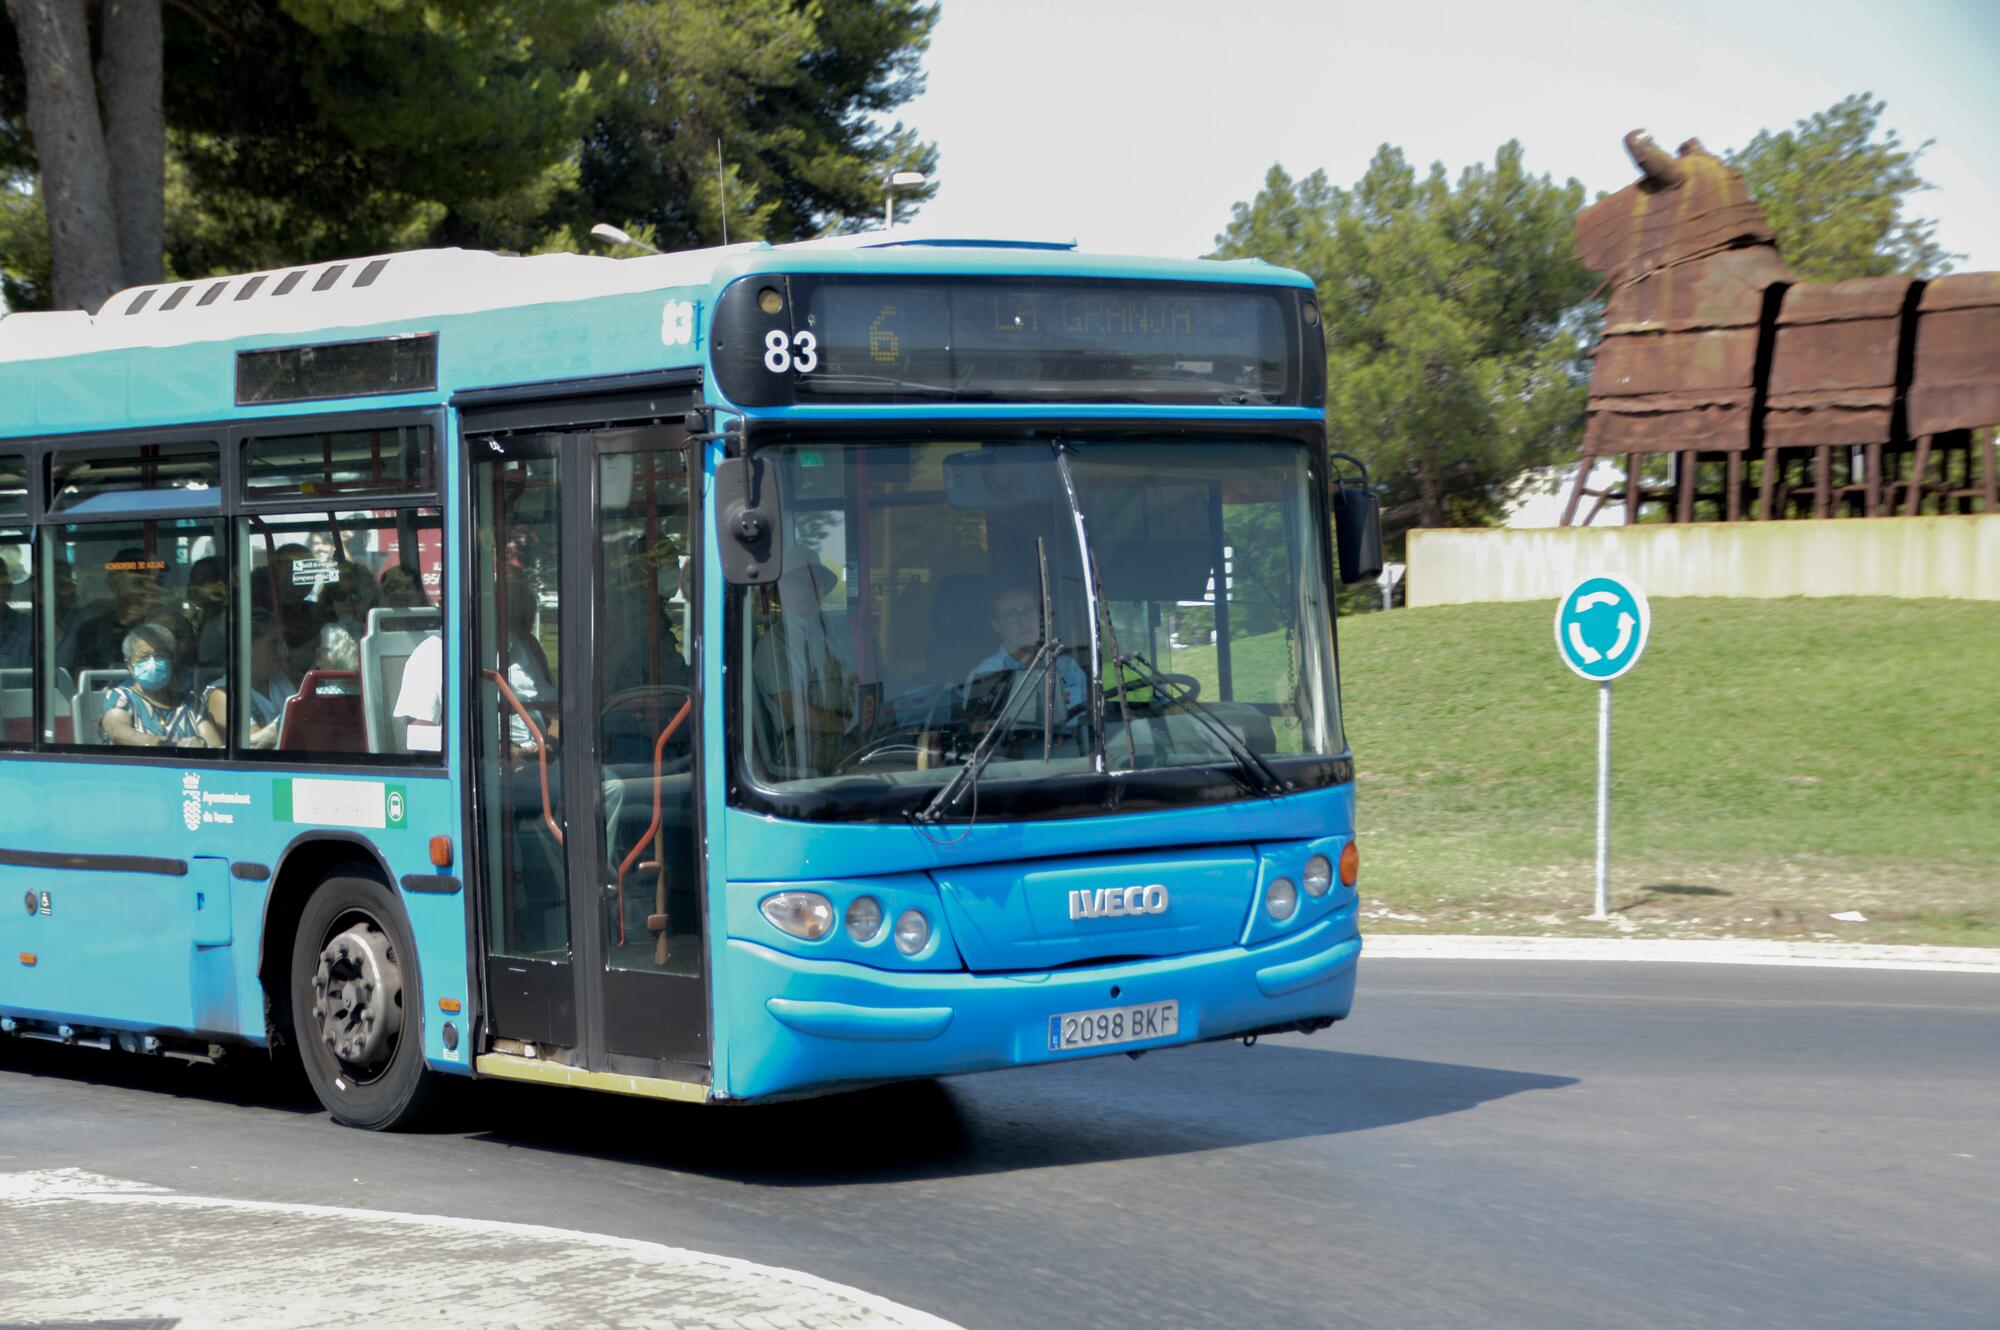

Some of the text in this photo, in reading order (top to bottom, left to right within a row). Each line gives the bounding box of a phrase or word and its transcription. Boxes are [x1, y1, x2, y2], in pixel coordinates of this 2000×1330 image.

[869, 304, 899, 362] 6
[994, 300, 1192, 334] LA GRANJA
[764, 329, 818, 373] 83
[1069, 884, 1169, 920] IVECO
[1065, 1005, 1173, 1044] 2098 BKF
